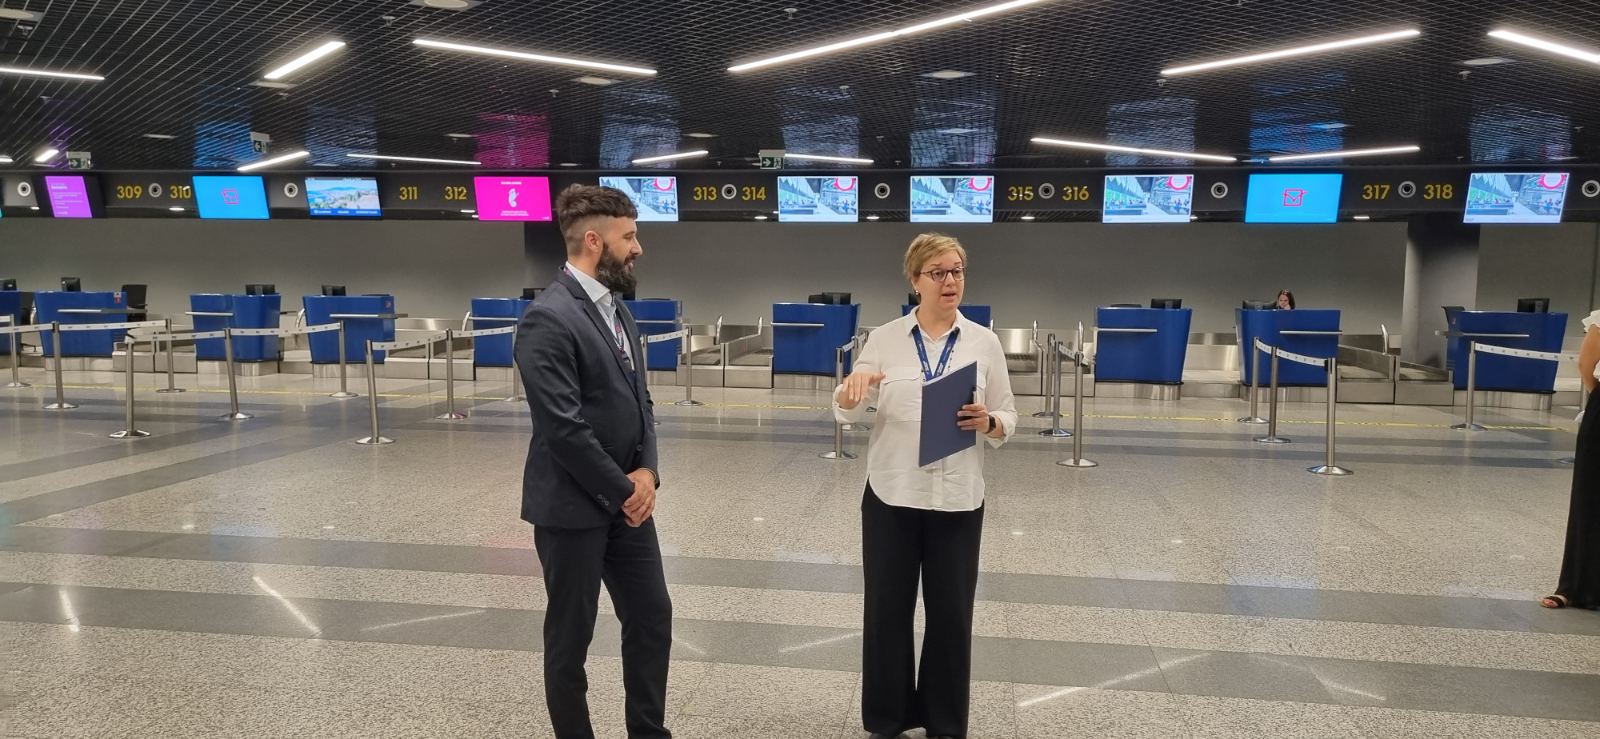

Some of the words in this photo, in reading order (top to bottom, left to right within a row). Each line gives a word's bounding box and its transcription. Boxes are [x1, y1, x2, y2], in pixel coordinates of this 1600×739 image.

[116, 185, 143, 199] 309
[169, 185, 192, 199] 310
[399, 186, 418, 200] 311
[444, 186, 468, 200] 312
[693, 186, 718, 200] 313
[741, 186, 767, 200] 314
[1007, 186, 1034, 200] 315
[1062, 186, 1090, 200] 316
[1362, 184, 1390, 200] 317
[1423, 184, 1453, 199] 318
